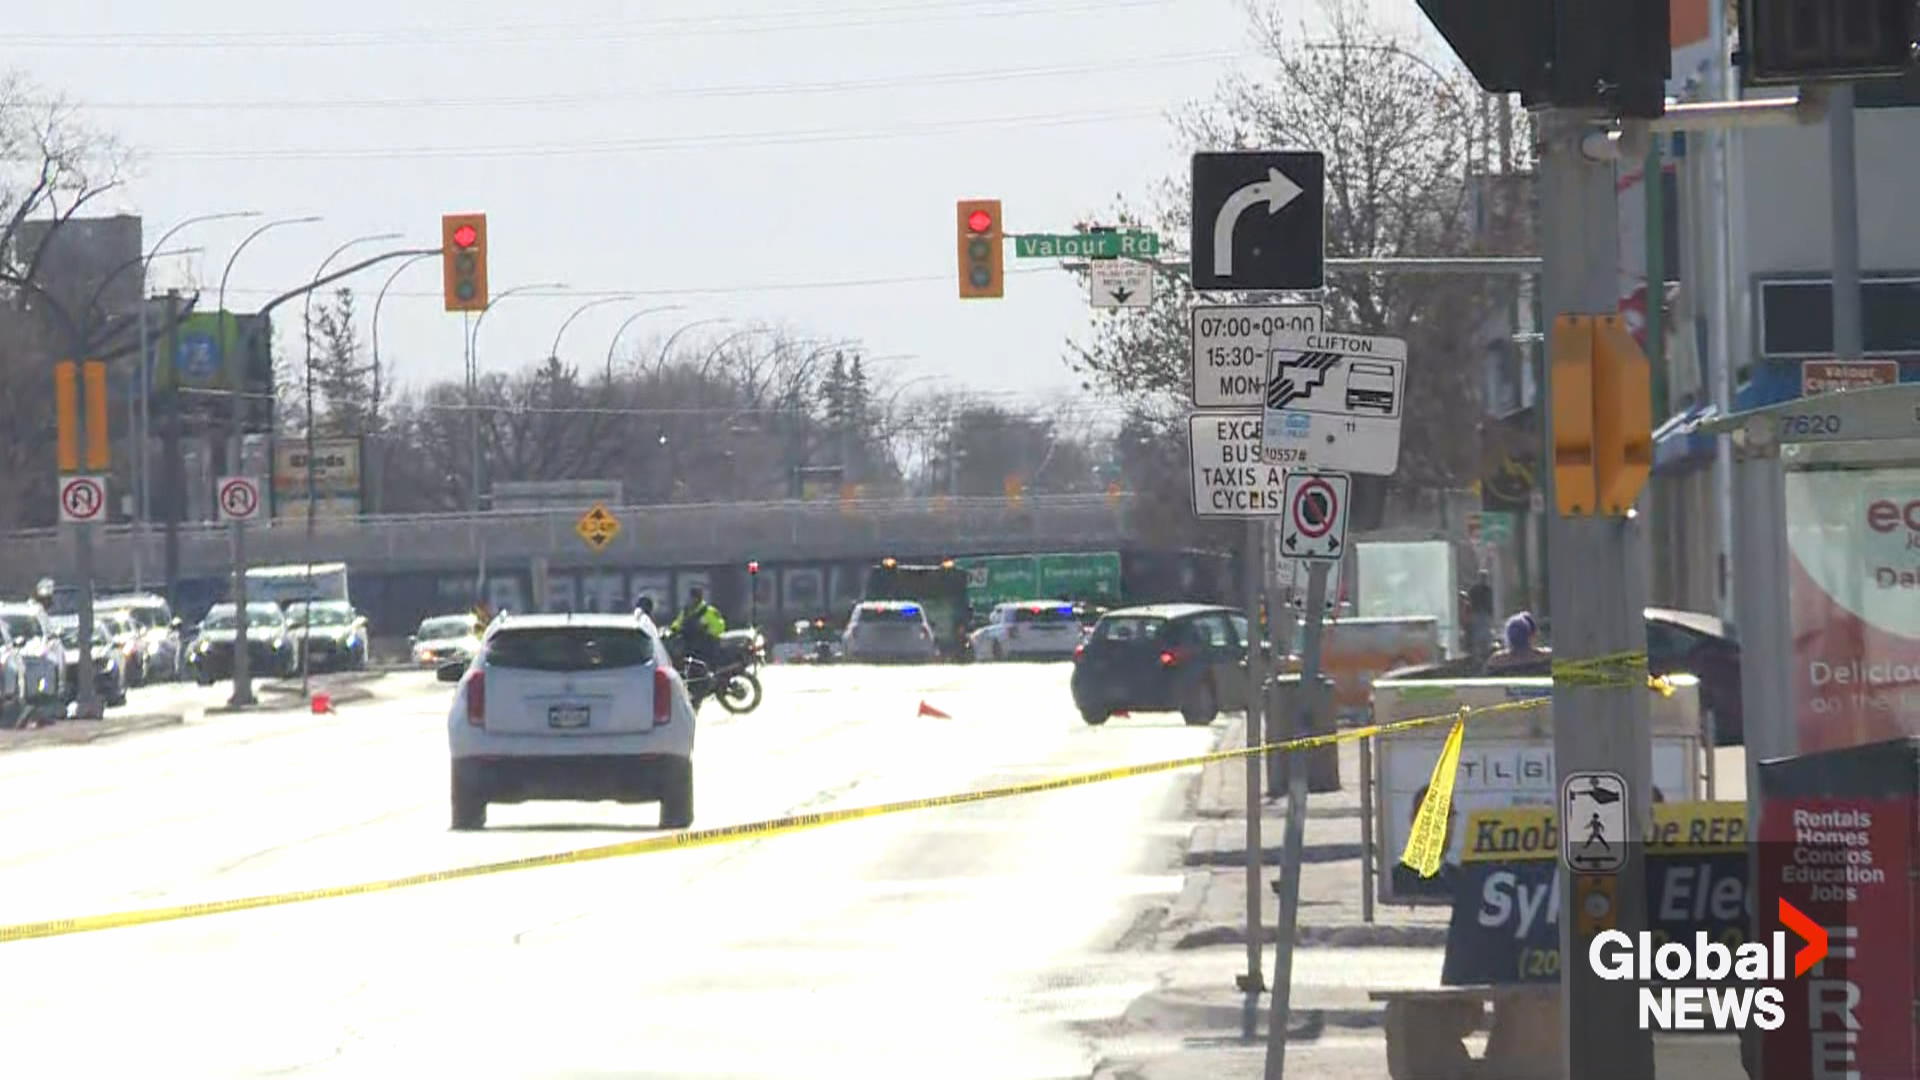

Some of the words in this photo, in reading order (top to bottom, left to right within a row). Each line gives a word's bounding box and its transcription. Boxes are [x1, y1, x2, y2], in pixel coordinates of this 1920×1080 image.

[1024, 238, 1106, 256] Valour
[1121, 235, 1151, 253] Rd
[1306, 335, 1373, 352] CLIFTON
[1207, 347, 1264, 367] 15:30-
[1220, 376, 1266, 396] MON-
[1217, 421, 1262, 441] EXCE
[1345, 422, 1356, 433] 11
[1781, 414, 1841, 434] 7620
[1223, 445, 1262, 463] BUS
[1202, 468, 1256, 486] TAXIS
[1213, 490, 1281, 509] CYCLIS
[1793, 809, 1872, 828] Rentals
[1474, 816, 1558, 853] Knob
[1689, 817, 1745, 845] REP
[1795, 828, 1870, 846] Homes
[1793, 846, 1873, 864] Condos
[1782, 864, 1885, 883] Education
[1810, 883, 1858, 901] Jobs
[1478, 870, 1560, 938] Syl
[1517, 949, 1558, 980] (20
